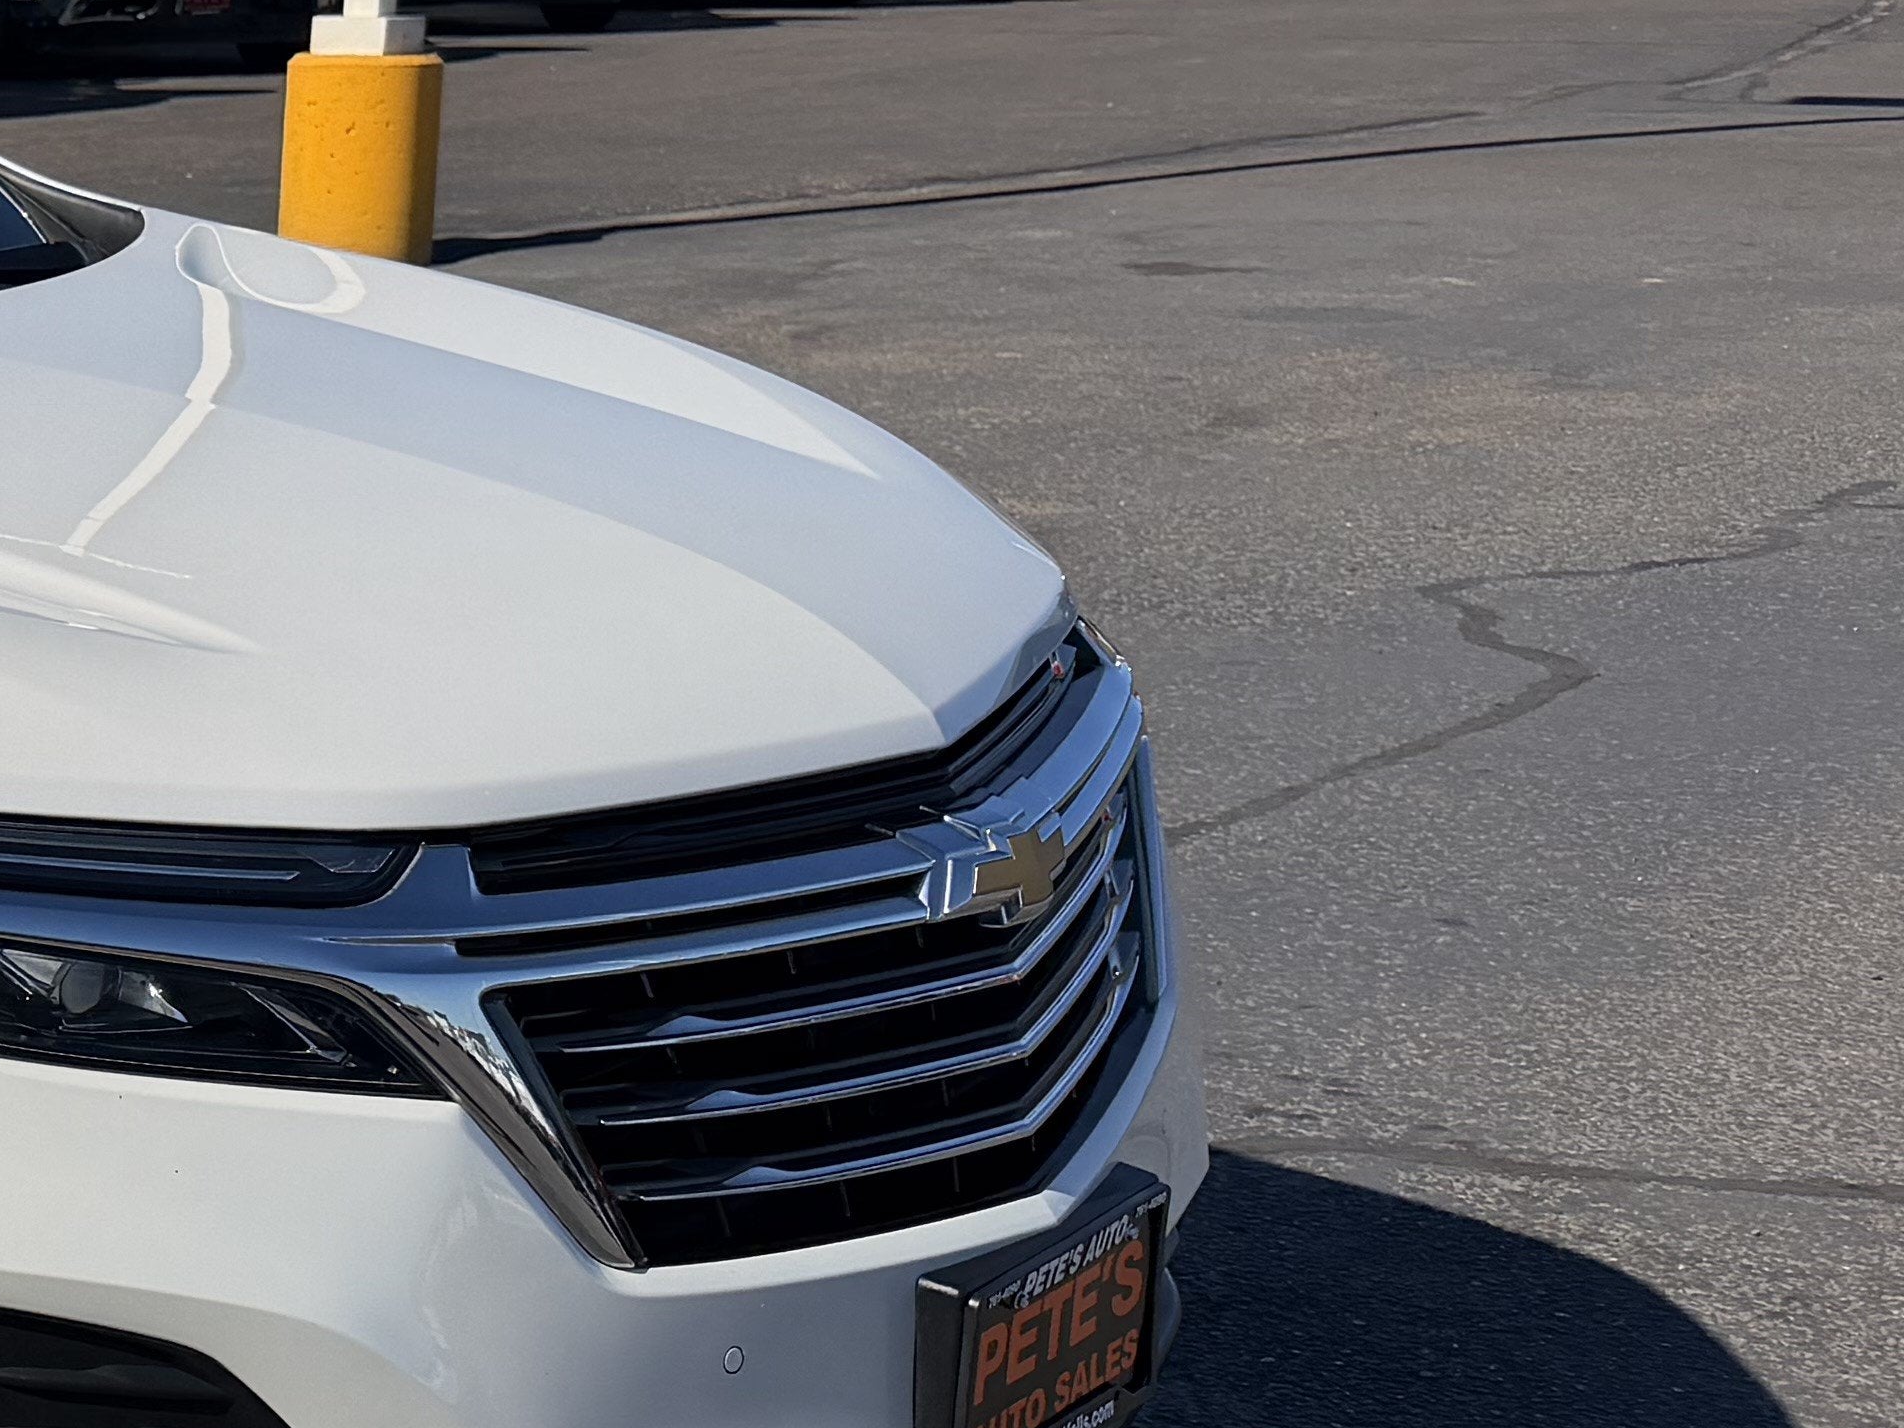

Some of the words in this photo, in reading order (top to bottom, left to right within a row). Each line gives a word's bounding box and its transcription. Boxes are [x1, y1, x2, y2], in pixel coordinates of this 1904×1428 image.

[1023, 1243, 1084, 1297] PETE'S
[1083, 1214, 1130, 1266] AUTO
[973, 1239, 1143, 1405] PETE'S
[1054, 1328, 1139, 1413] SALES
